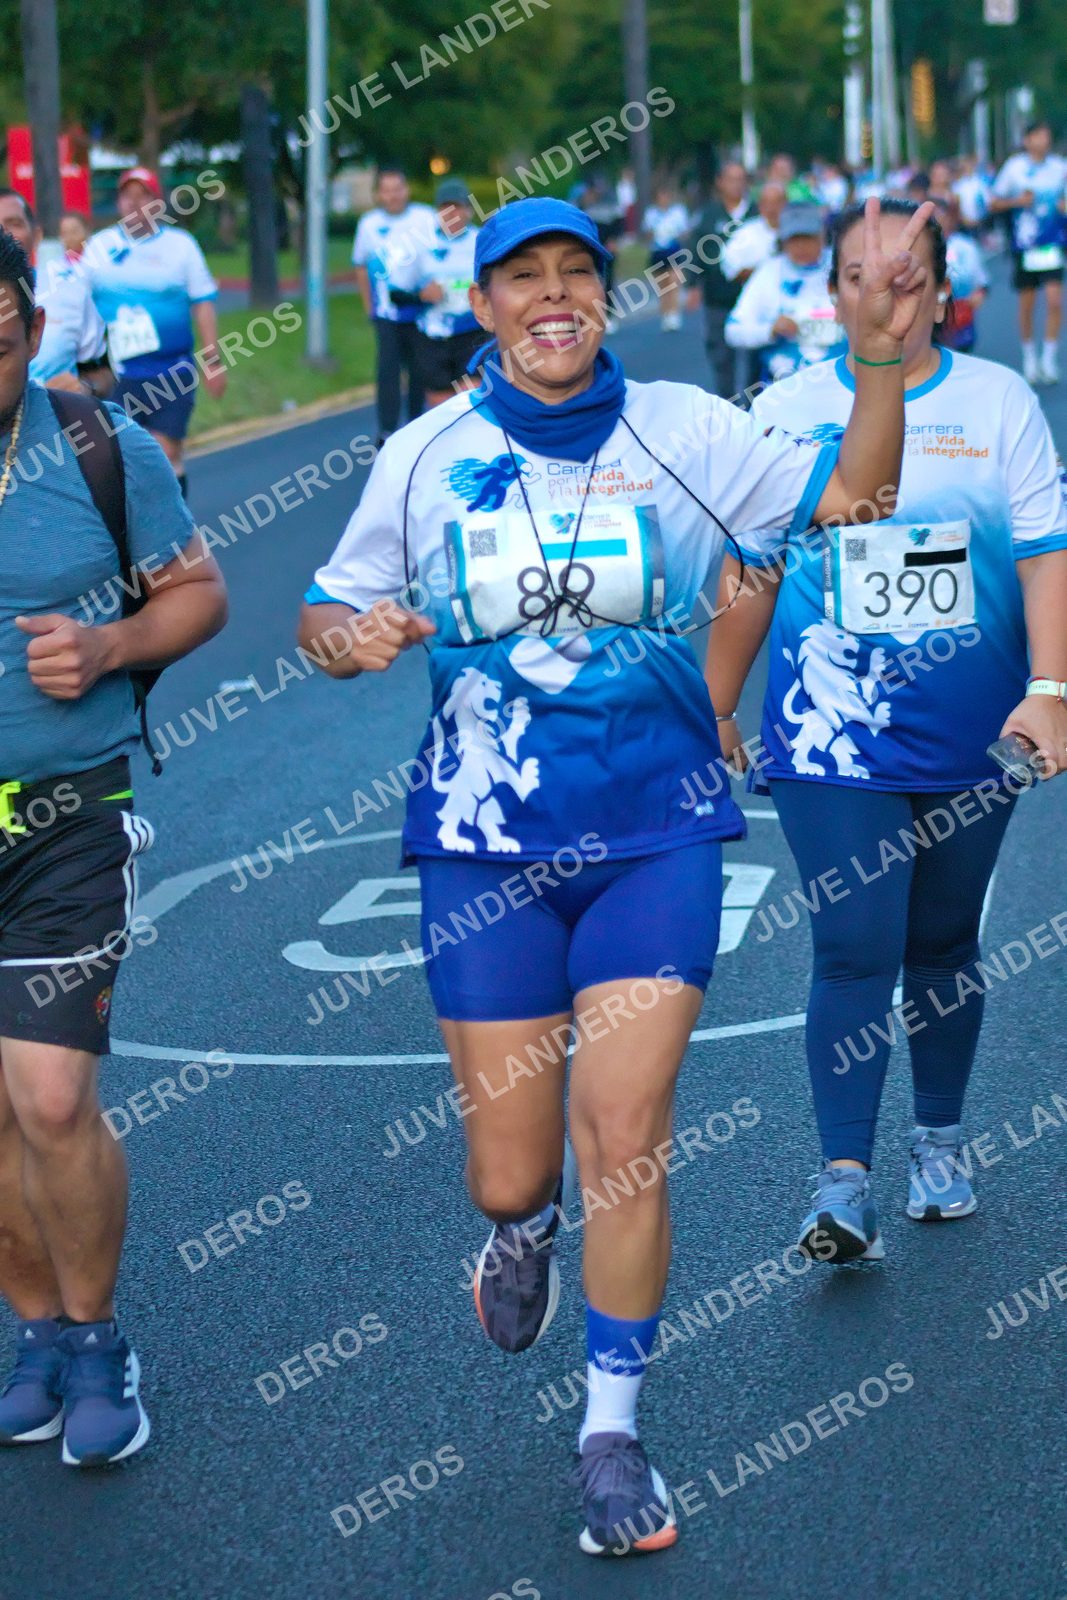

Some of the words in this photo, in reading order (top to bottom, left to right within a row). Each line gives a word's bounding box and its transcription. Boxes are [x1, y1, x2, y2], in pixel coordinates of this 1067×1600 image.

[936, 436, 965, 446] Vida
[923, 447, 989, 459] Integridad
[547, 458, 622, 475] Carrera
[548, 477, 570, 489] por
[592, 469, 625, 483] Vida
[576, 479, 654, 496] Integridad
[517, 562, 595, 620] 89
[864, 568, 958, 617] 390
